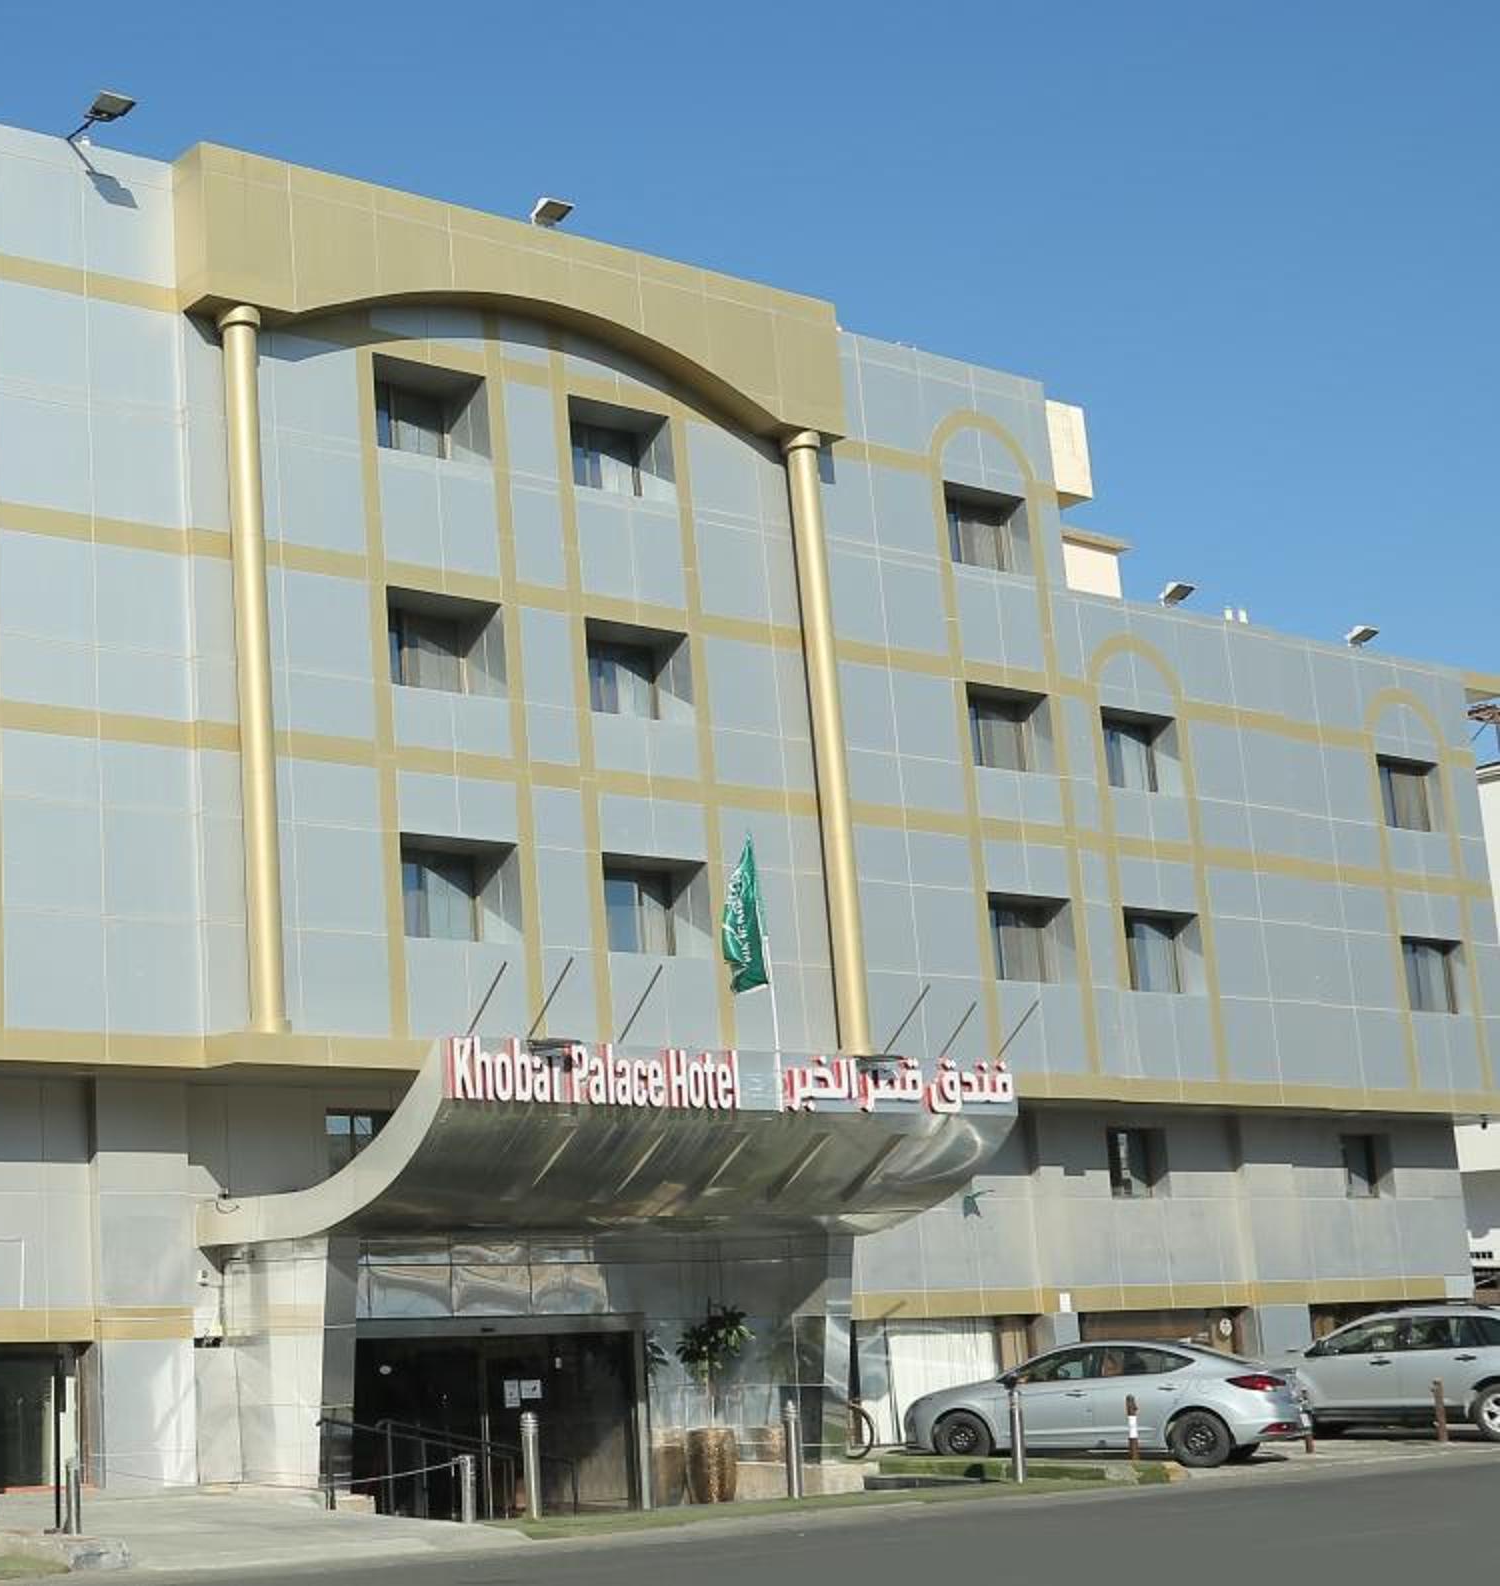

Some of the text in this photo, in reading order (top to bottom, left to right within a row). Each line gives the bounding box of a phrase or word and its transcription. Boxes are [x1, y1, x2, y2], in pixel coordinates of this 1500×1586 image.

[448, 1036, 741, 1110] Khobar Palace Hotel
[781, 1055, 1013, 1113] فندق قصر الخبر
